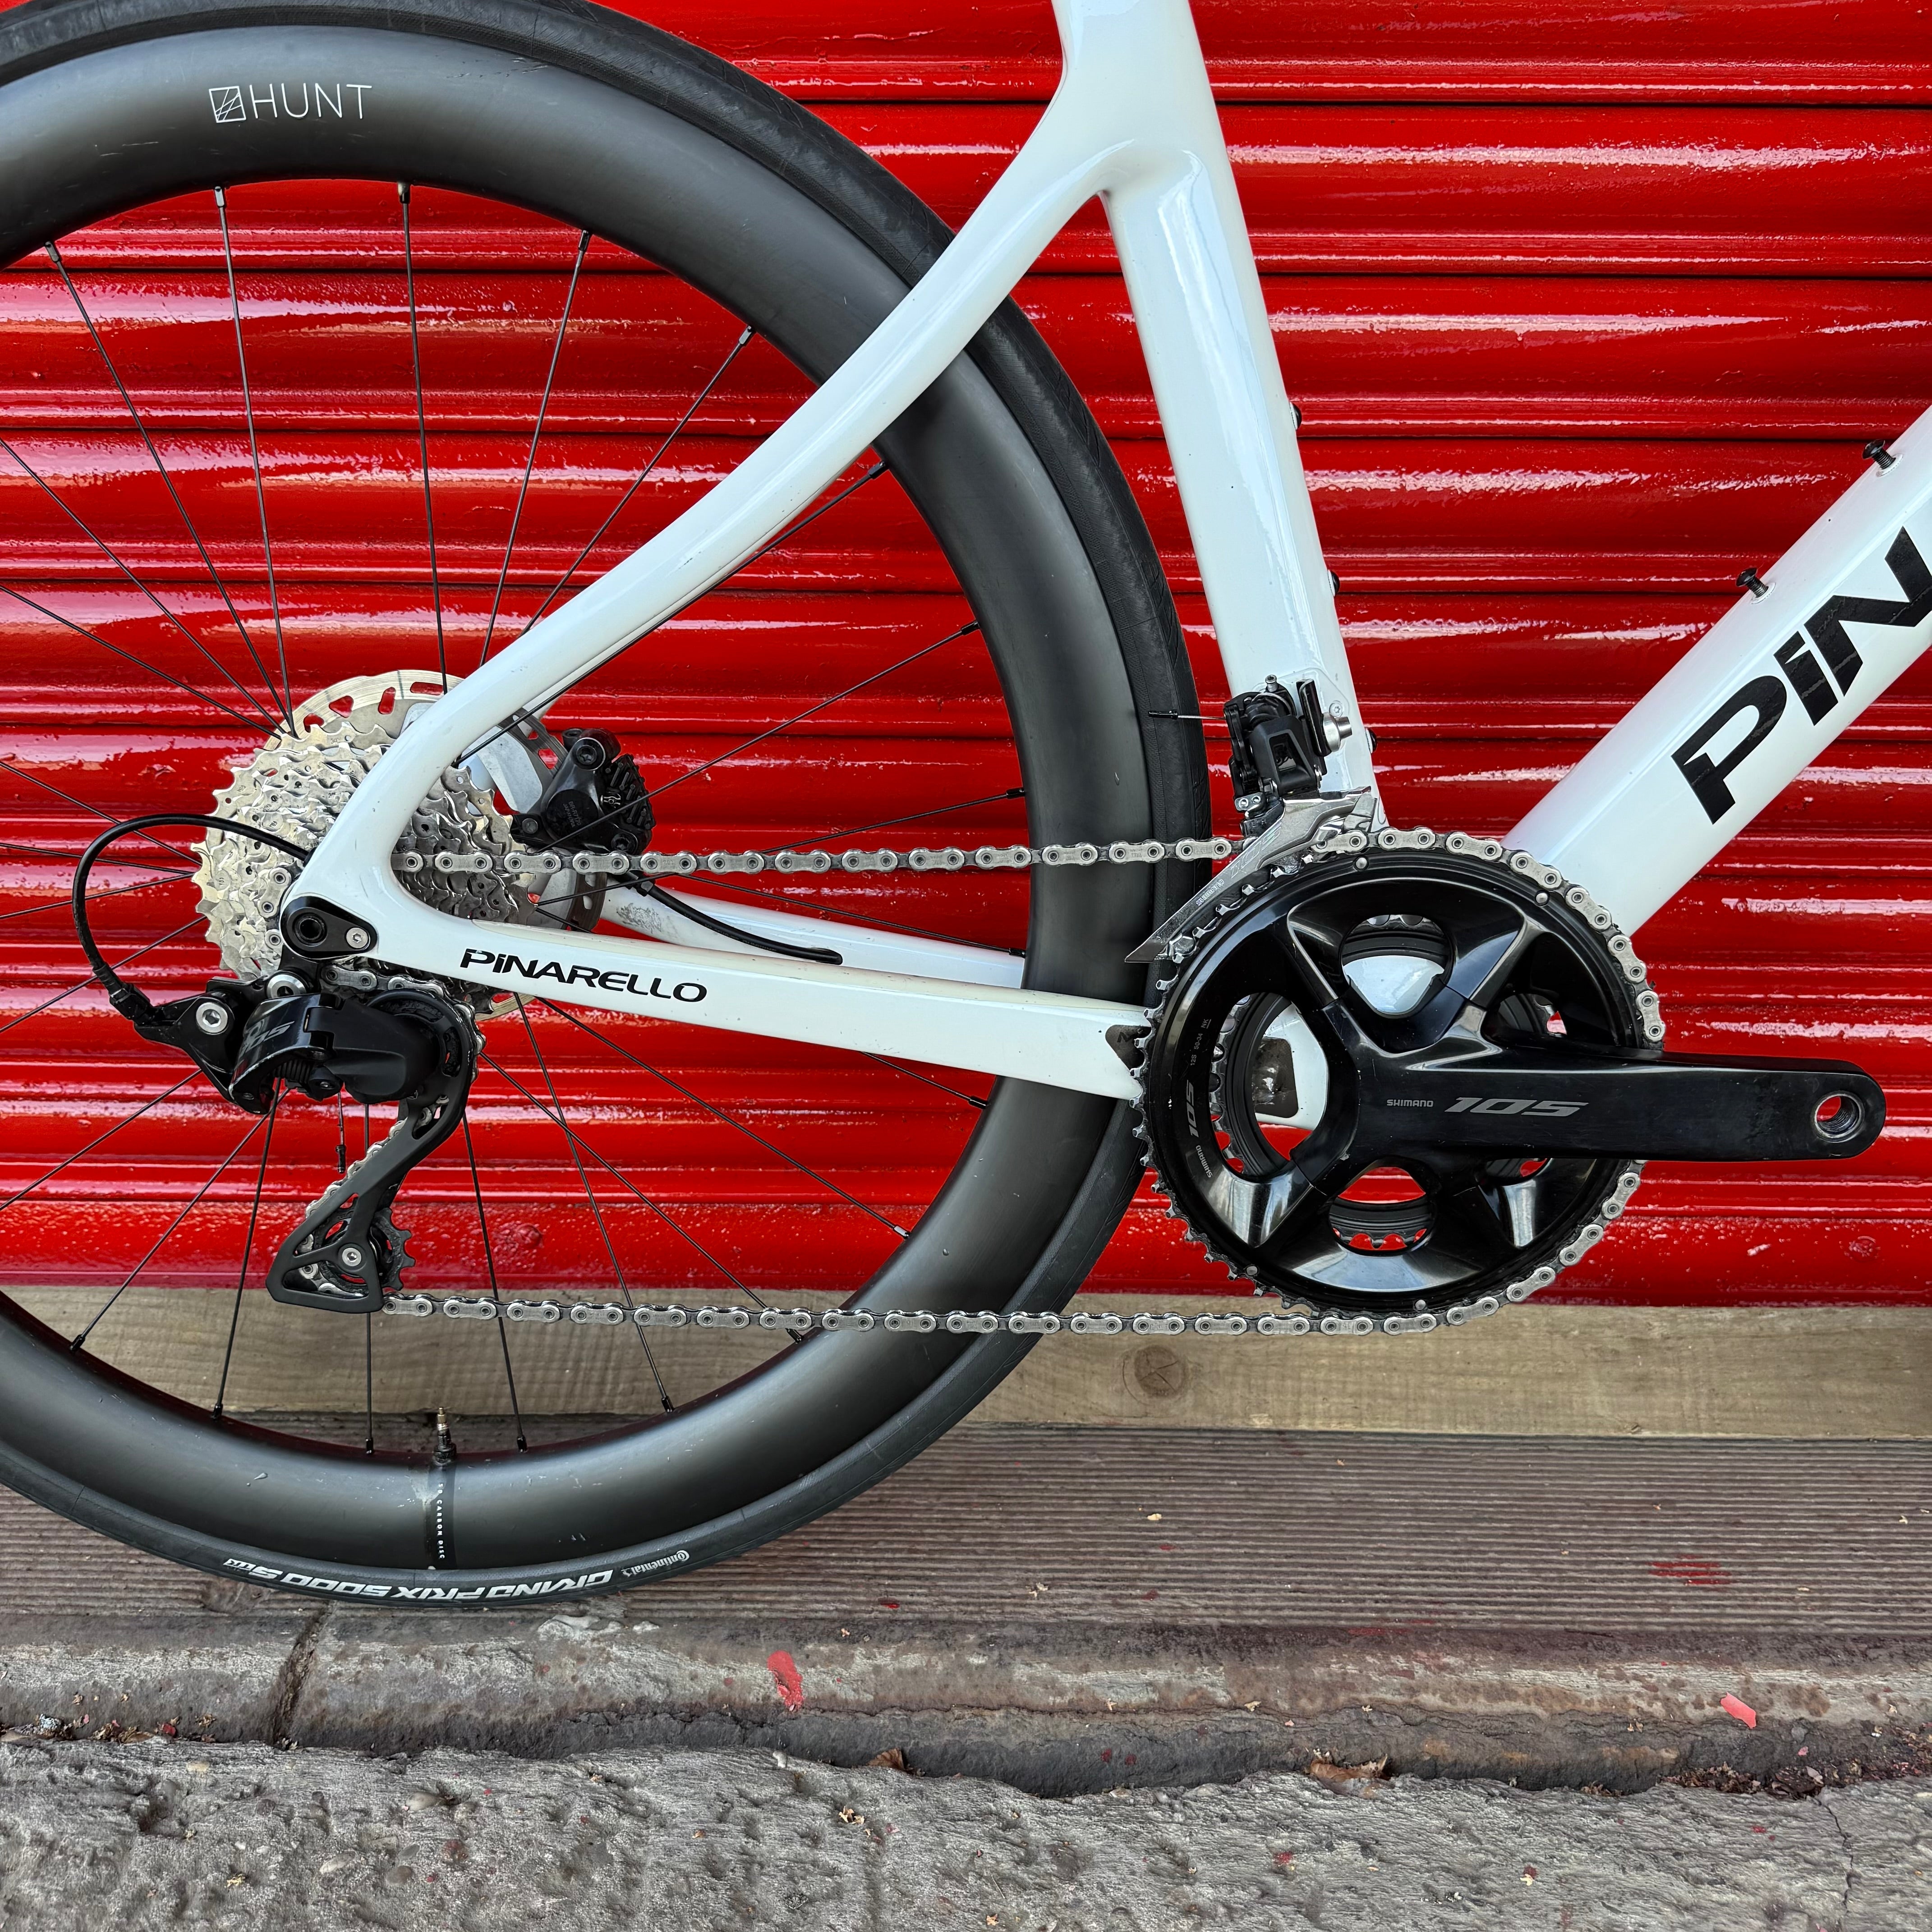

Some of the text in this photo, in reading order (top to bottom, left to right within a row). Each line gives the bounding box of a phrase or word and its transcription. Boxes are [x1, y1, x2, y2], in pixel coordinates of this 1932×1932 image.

[249, 83, 372, 119] HUNT
[1194, 1033, 1203, 1050] 50-34
[1201, 1019, 1211, 1029] NK
[1387, 1097, 1589, 1117] SHIMANO 105
[1186, 1079, 1213, 1178] SHIMANO 105
[249, 1566, 283, 1579] S
[632, 1550, 690, 1576] Continental
[280, 1573, 391, 1596] 5000
[391, 1586, 485, 1600] PRIX
[485, 1569, 613, 1598] GRAND
